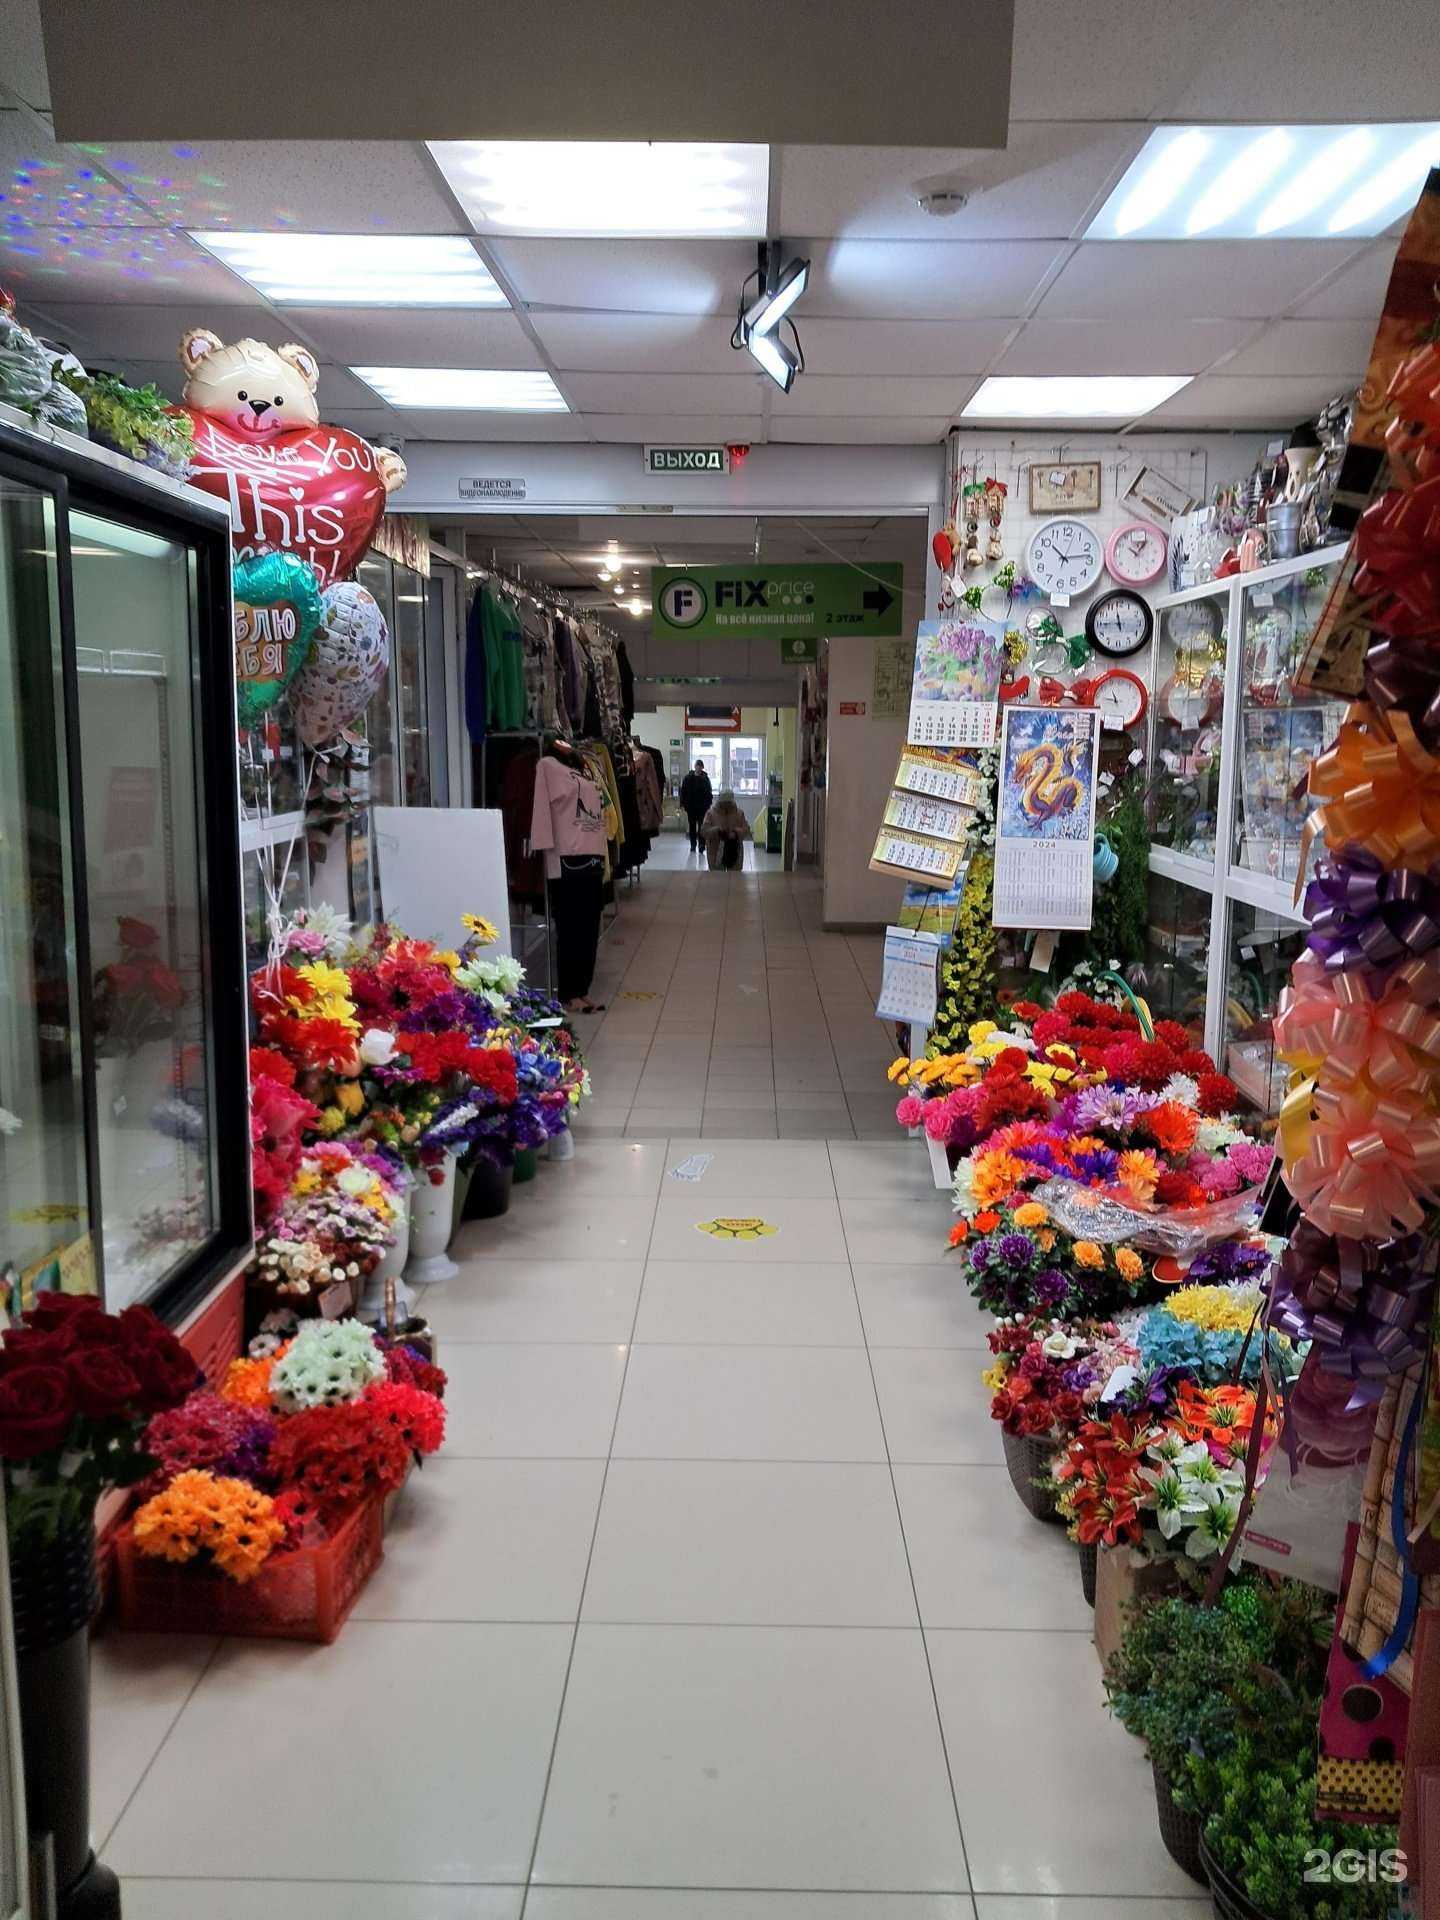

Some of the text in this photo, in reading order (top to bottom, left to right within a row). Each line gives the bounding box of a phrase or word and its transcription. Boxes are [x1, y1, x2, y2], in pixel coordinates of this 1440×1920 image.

[303, 437, 371, 476] You
[654, 452, 720, 469] ВЫХОД
[472, 480, 511, 489] ВЕДЕТСЯ
[191, 466, 345, 547] This
[1052, 529, 1059, 540] 11
[1063, 527, 1073, 537] 12
[1078, 532, 1082, 541] 1
[1041, 538, 1052, 548] 10
[1083, 543, 1091, 552] 2
[1035, 550, 1043, 560] 9
[1037, 563, 1045, 573] 8
[1080, 569, 1087, 578] 4
[1045, 574, 1053, 584] 7
[1056, 578, 1064, 589] 6
[1069, 576, 1077, 586] 5
[715, 580, 815, 607] FIX price
[715, 614, 728, 624] На
[826, 613, 833, 623] 2
[235, 608, 296, 642] БЛЮ
[236, 643, 283, 675] БЯ
[1032, 841, 1057, 849] 2024
